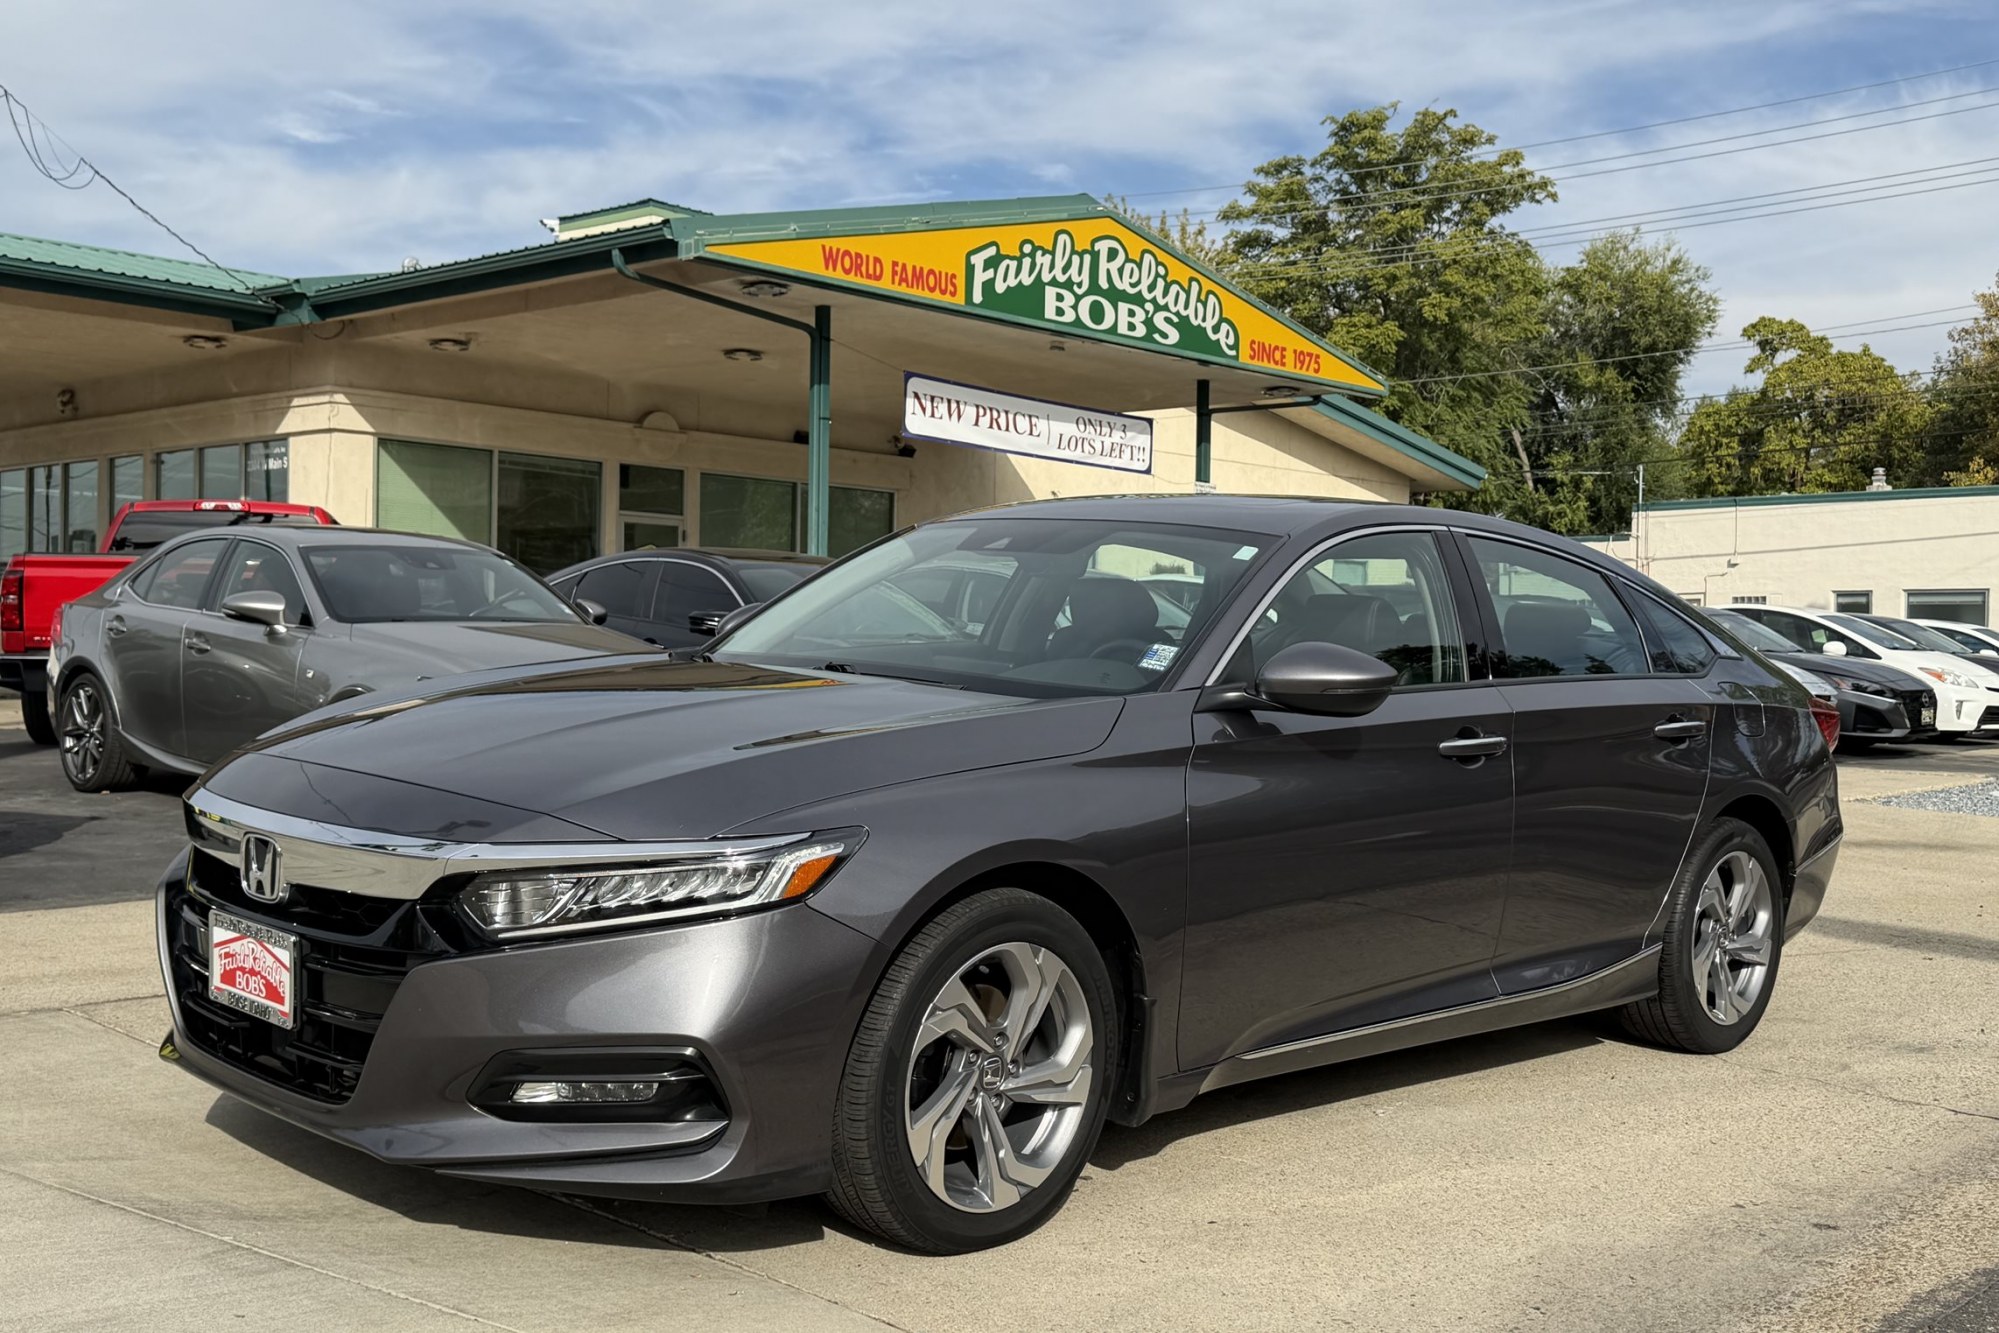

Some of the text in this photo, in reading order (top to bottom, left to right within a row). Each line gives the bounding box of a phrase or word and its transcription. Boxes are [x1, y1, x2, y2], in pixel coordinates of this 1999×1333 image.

[821, 244, 957, 298] WORLD FAMOUS
[970, 233, 1237, 356] Fairly Reliable
[1044, 285, 1180, 345] BOB'S
[1249, 339, 1321, 374] SINCE 1975
[911, 391, 1041, 437] NEW PRICE
[1075, 415, 1127, 439] ONLY 3
[1057, 433, 1146, 463] LOTS LEFT!!
[219, 943, 250, 974] Fairly
[236, 970, 266, 997] BOB'S
